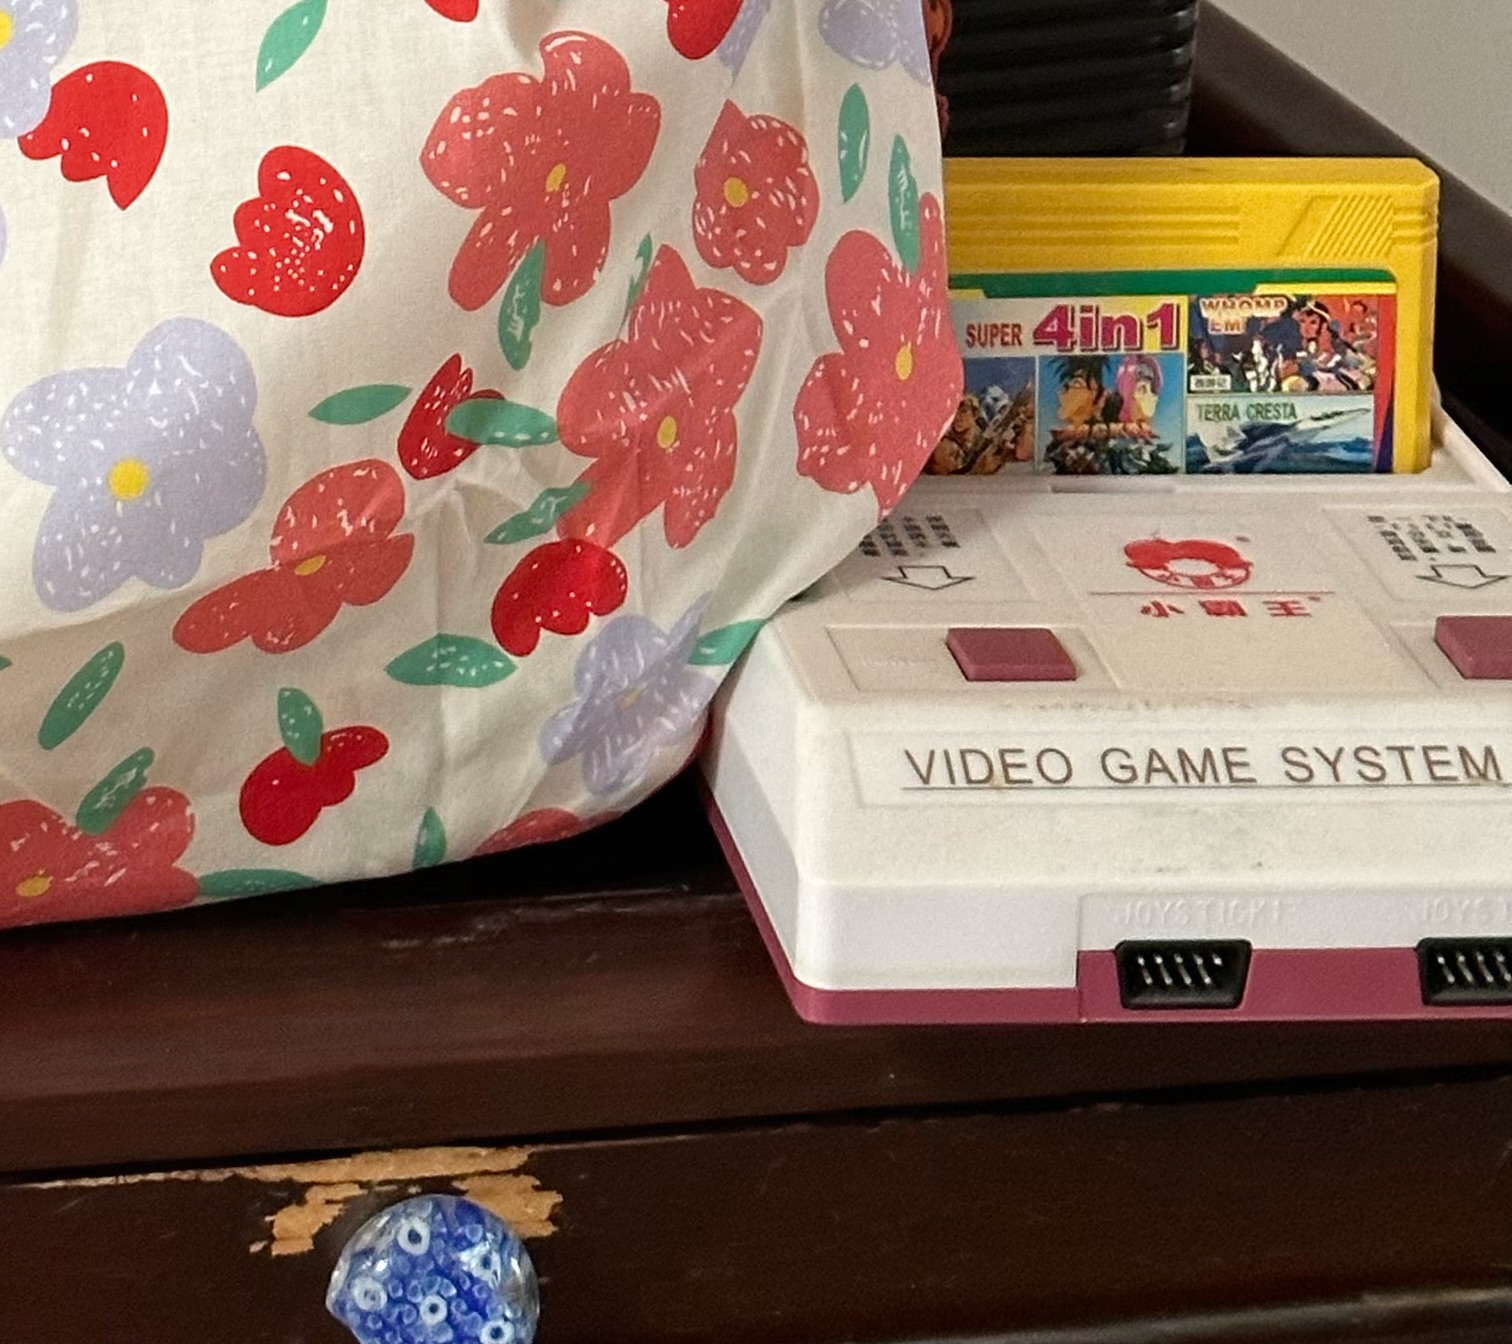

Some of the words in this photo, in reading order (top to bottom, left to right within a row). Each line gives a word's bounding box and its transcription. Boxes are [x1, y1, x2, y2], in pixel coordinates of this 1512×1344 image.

[965, 321, 1023, 349] SUPER
[1032, 301, 1181, 353] 4in1
[1196, 402, 1241, 422] TERRA
[1246, 402, 1298, 420] CRESTA
[904, 747, 1074, 787] VIDEO
[1099, 746, 1257, 785] GAME
[1280, 744, 1503, 784] SYSTEM
